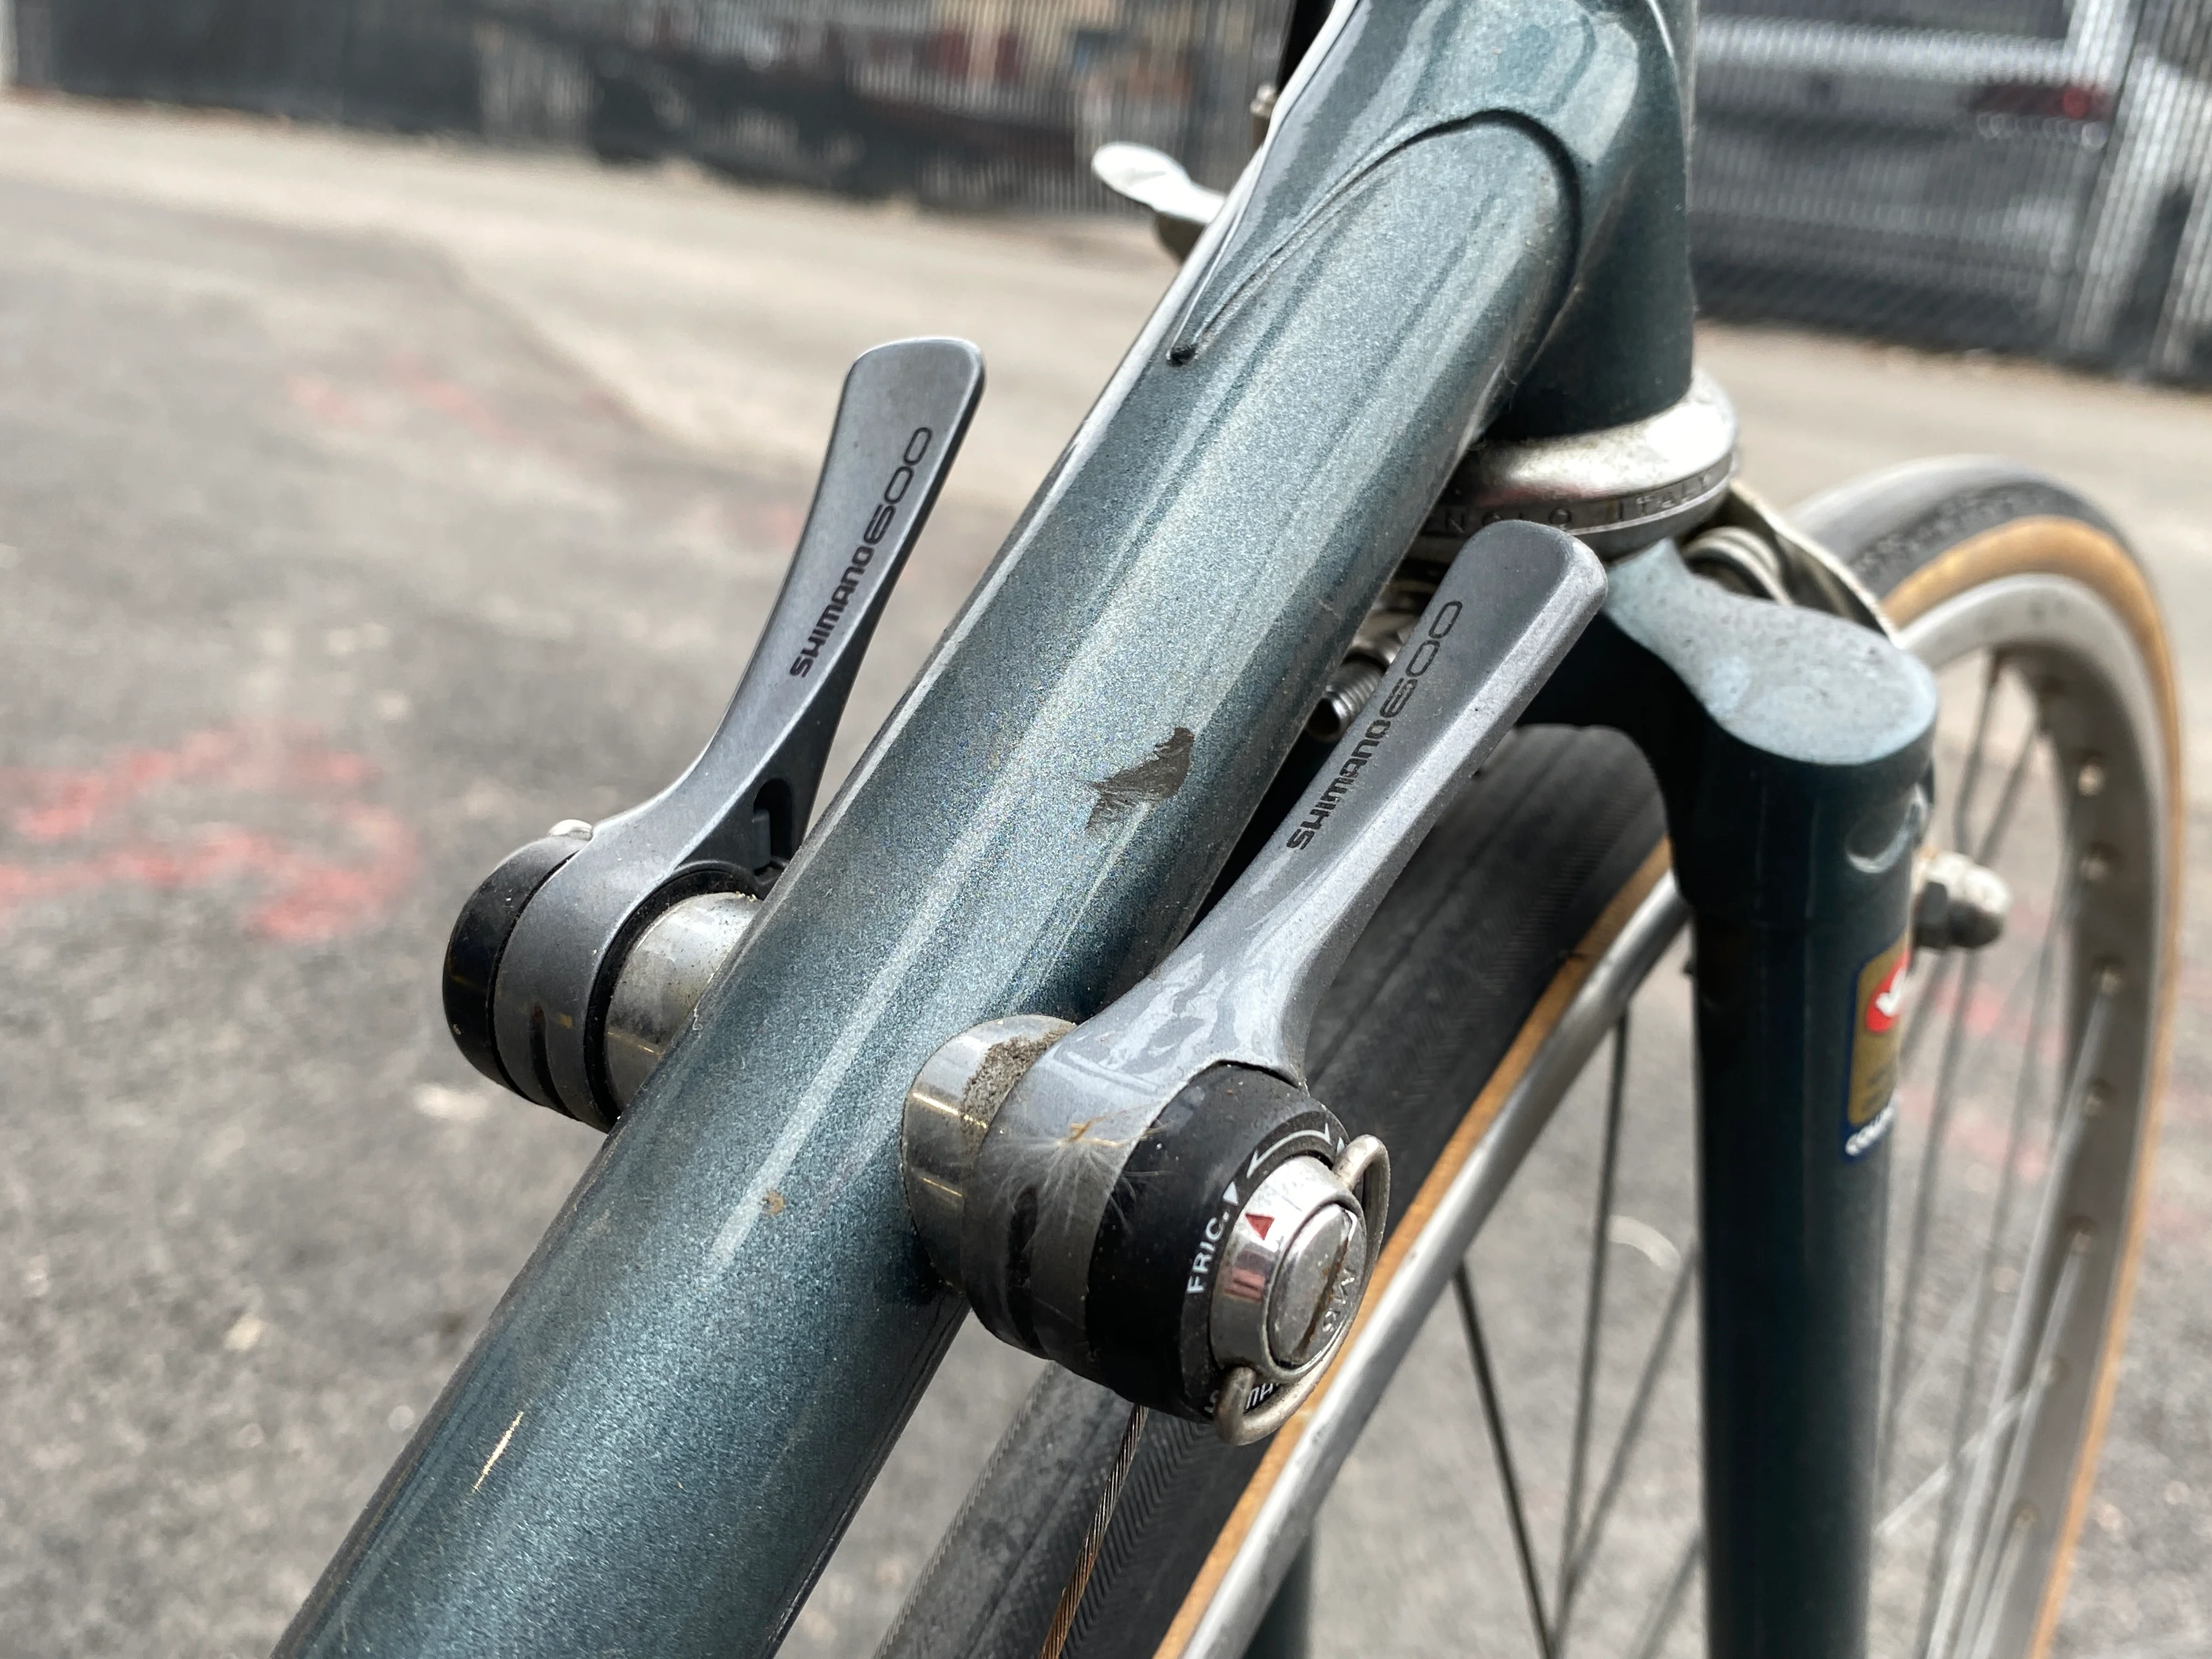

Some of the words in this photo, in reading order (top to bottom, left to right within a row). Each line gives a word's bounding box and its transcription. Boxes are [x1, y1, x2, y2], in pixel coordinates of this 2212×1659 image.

[864, 427, 932, 546] 600
[1379, 600, 1463, 719] 600
[1186, 1211, 1229, 1294] FRIC.
